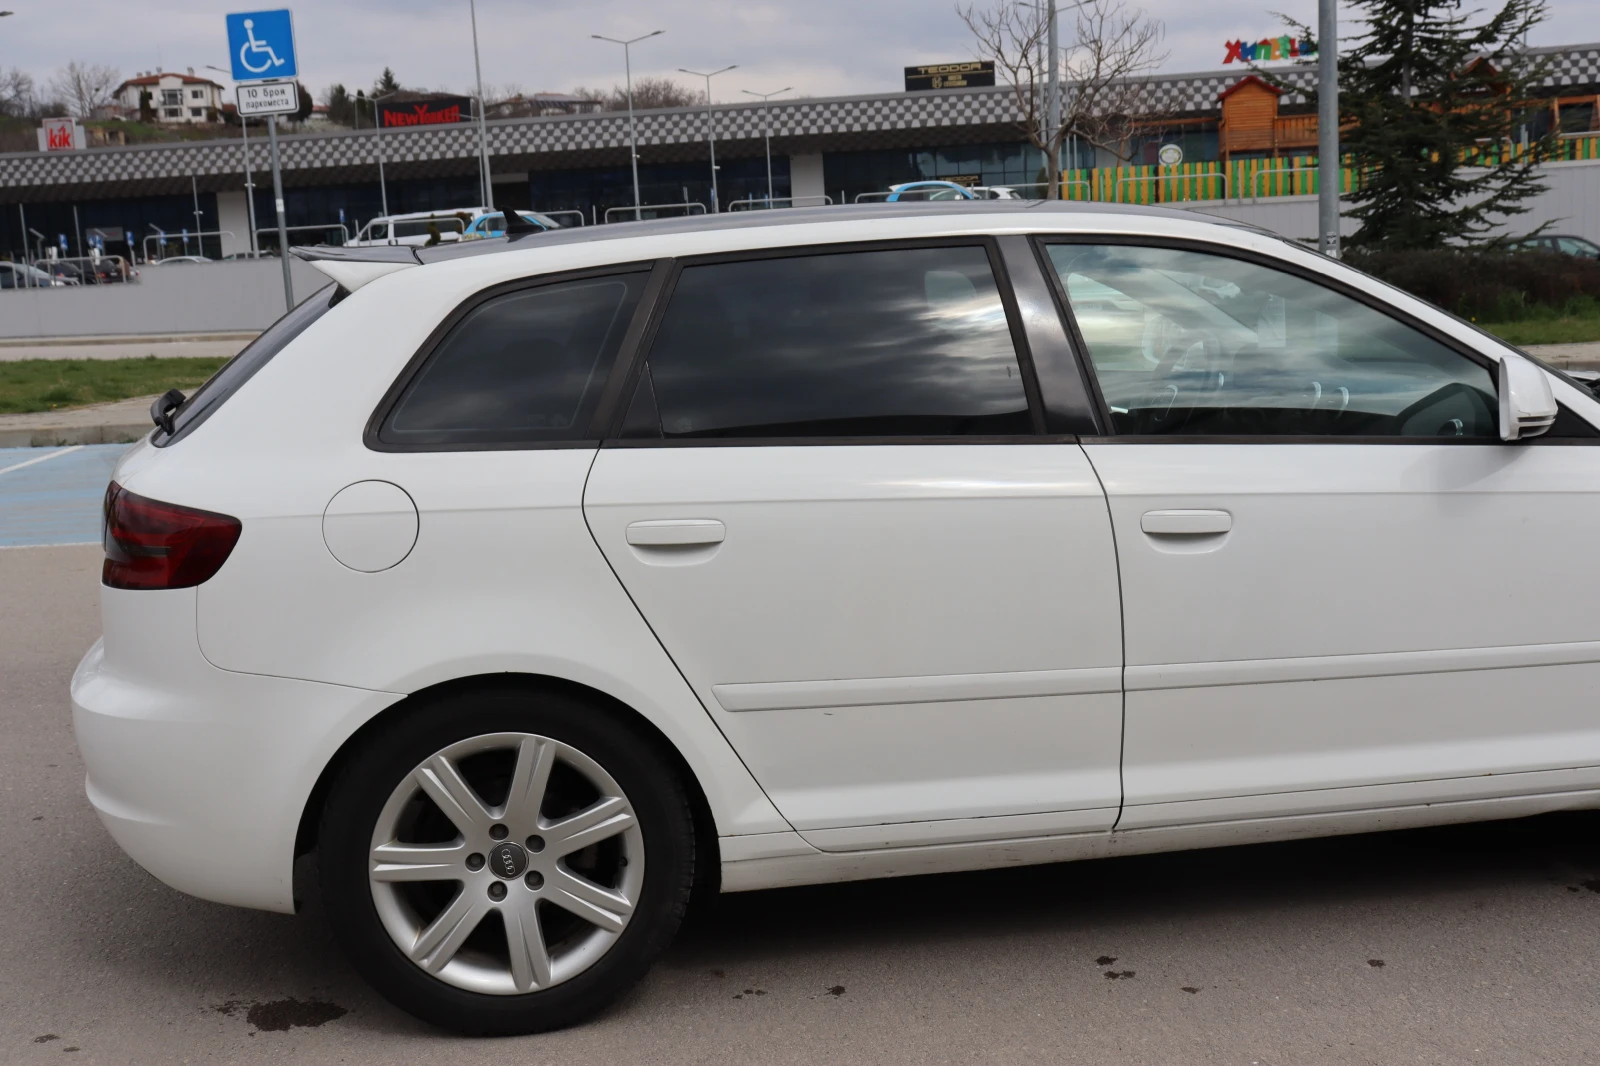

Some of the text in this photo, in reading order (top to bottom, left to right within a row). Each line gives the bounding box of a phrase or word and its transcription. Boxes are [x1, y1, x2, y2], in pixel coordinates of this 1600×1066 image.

[917, 62, 982, 74] TEODOR
[246, 87, 286, 99] 10 броя
[245, 98, 289, 109] паркоместа
